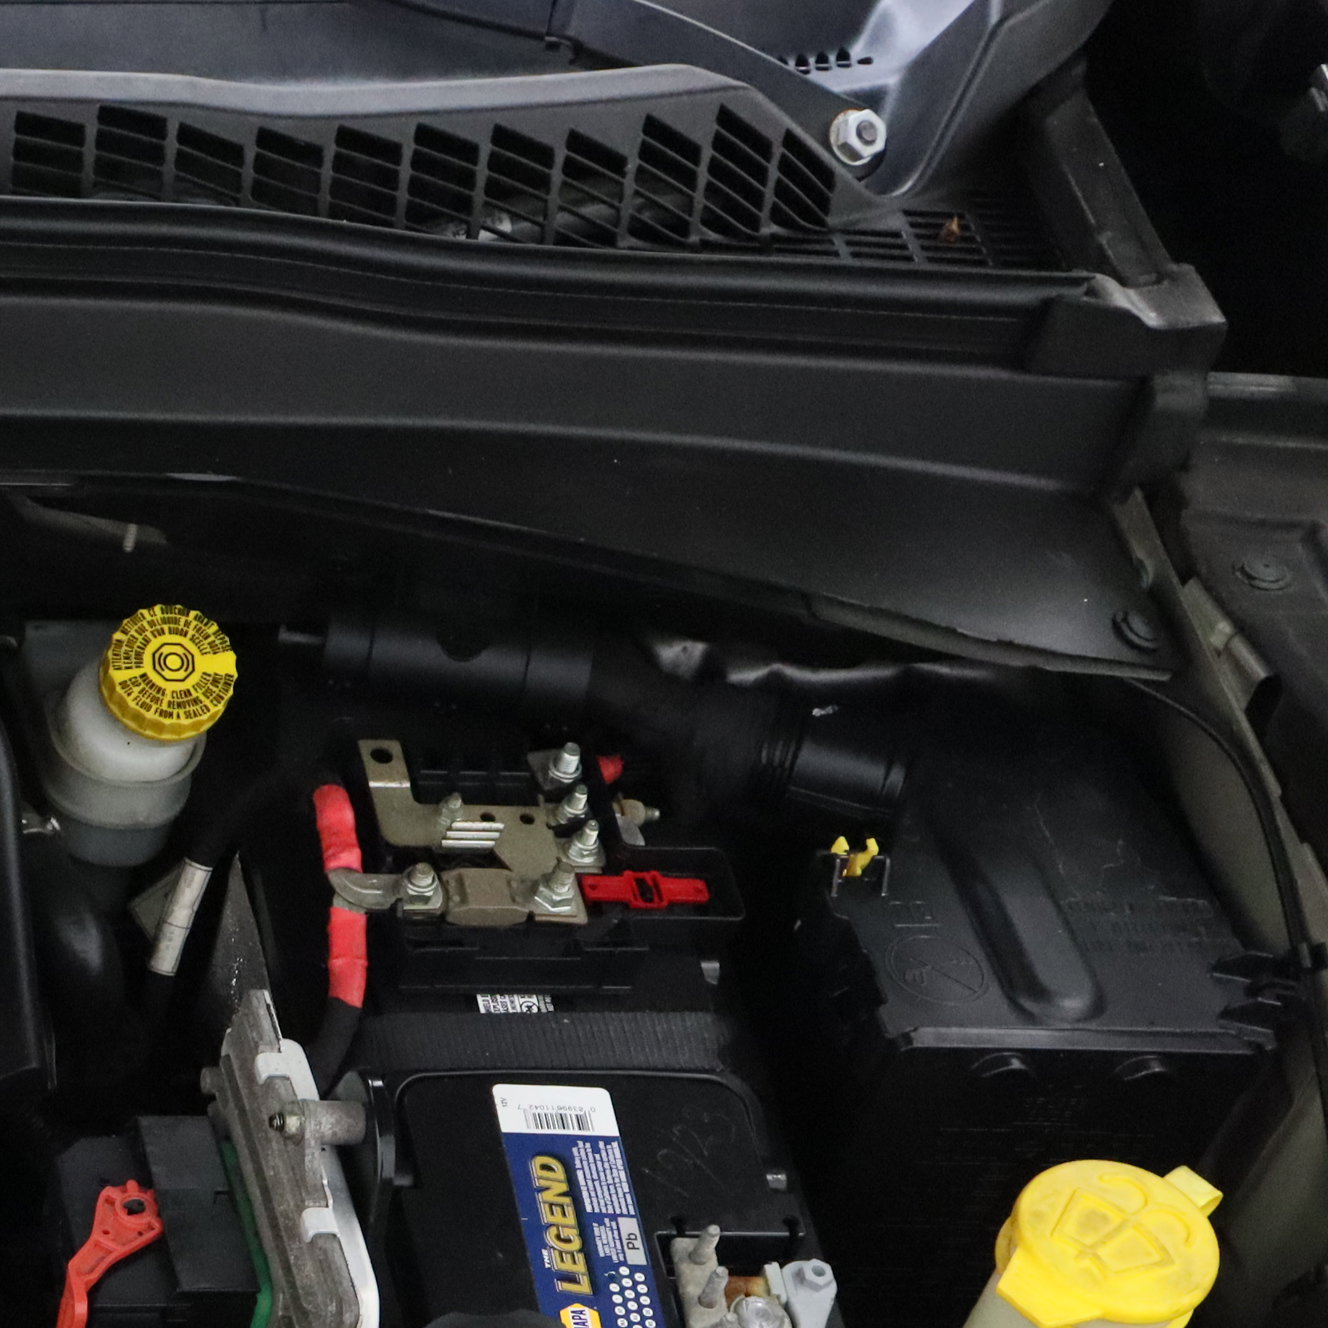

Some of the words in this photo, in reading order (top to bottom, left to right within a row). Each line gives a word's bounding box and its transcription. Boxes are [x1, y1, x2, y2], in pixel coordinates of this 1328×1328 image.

[133, 696, 153, 713] FLUID
[154, 709, 174, 720] FROM
[185, 705, 212, 721] SEALED
[210, 673, 235, 708] CONTAINER
[138, 686, 165, 708] BEFORE
[203, 689, 214, 700] USE
[172, 689, 193, 700] CLEAN
[193, 672, 213, 694] FILLER
[529, 1155, 593, 1295] LEGEND
[626, 1233, 639, 1251] Pb
[542, 1248, 551, 1269] THE
